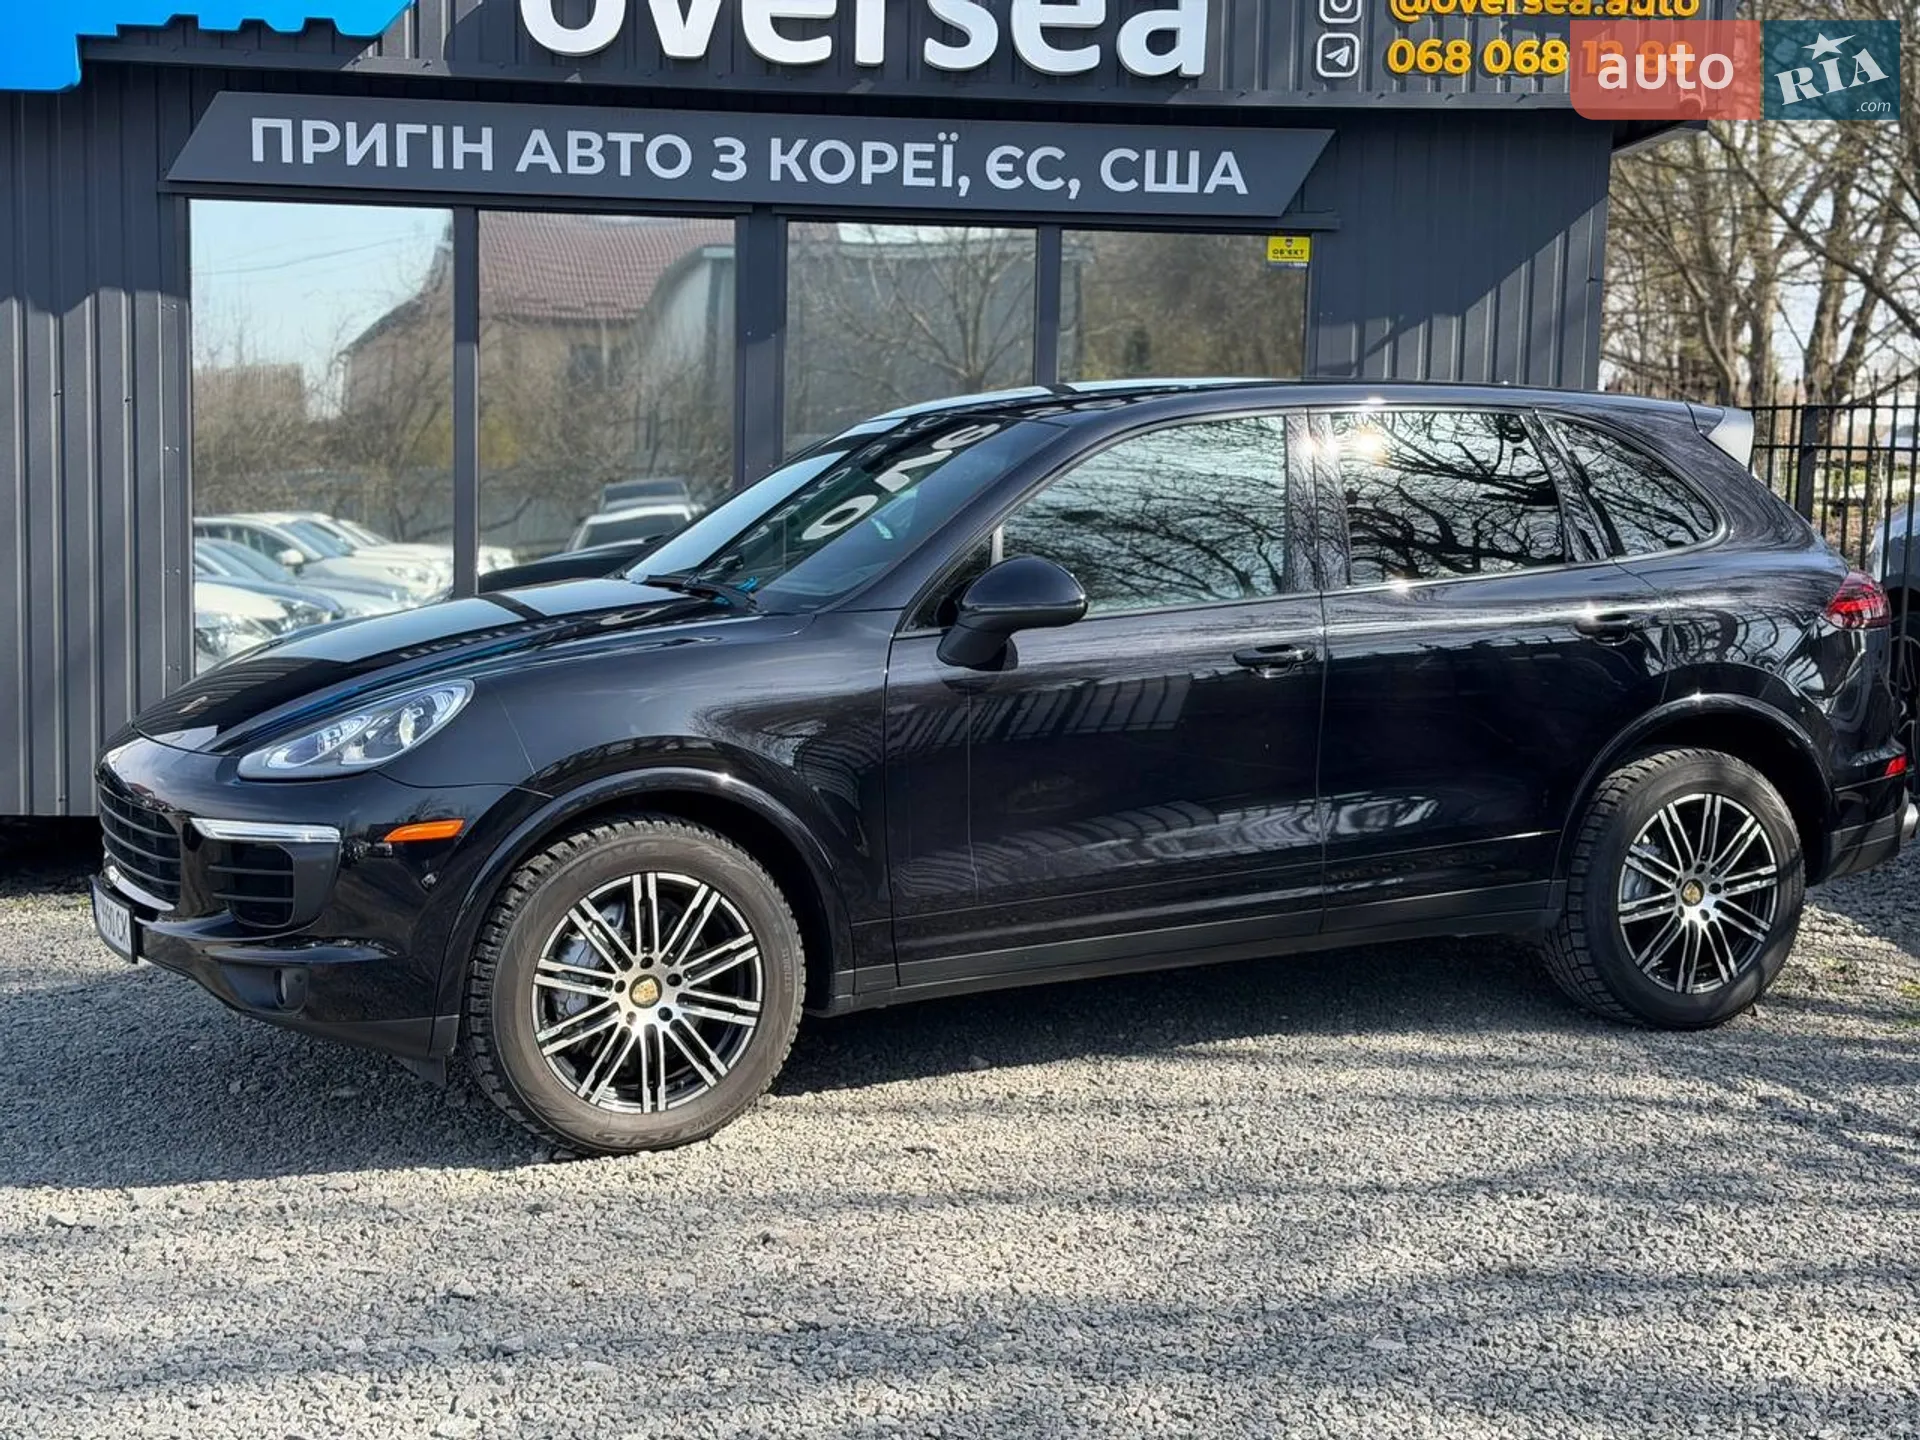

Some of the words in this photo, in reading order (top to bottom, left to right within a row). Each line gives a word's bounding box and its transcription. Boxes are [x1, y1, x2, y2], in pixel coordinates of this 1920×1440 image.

[1387, 38, 1472, 74] 068
[1483, 39, 1568, 74] 068
[251, 117, 494, 171] ПРИГІН
[515, 129, 692, 179] АВТО
[769, 132, 971, 197] КОРЕЇ,
[985, 145, 1081, 200] ЄС,
[1100, 148, 1249, 195] США
